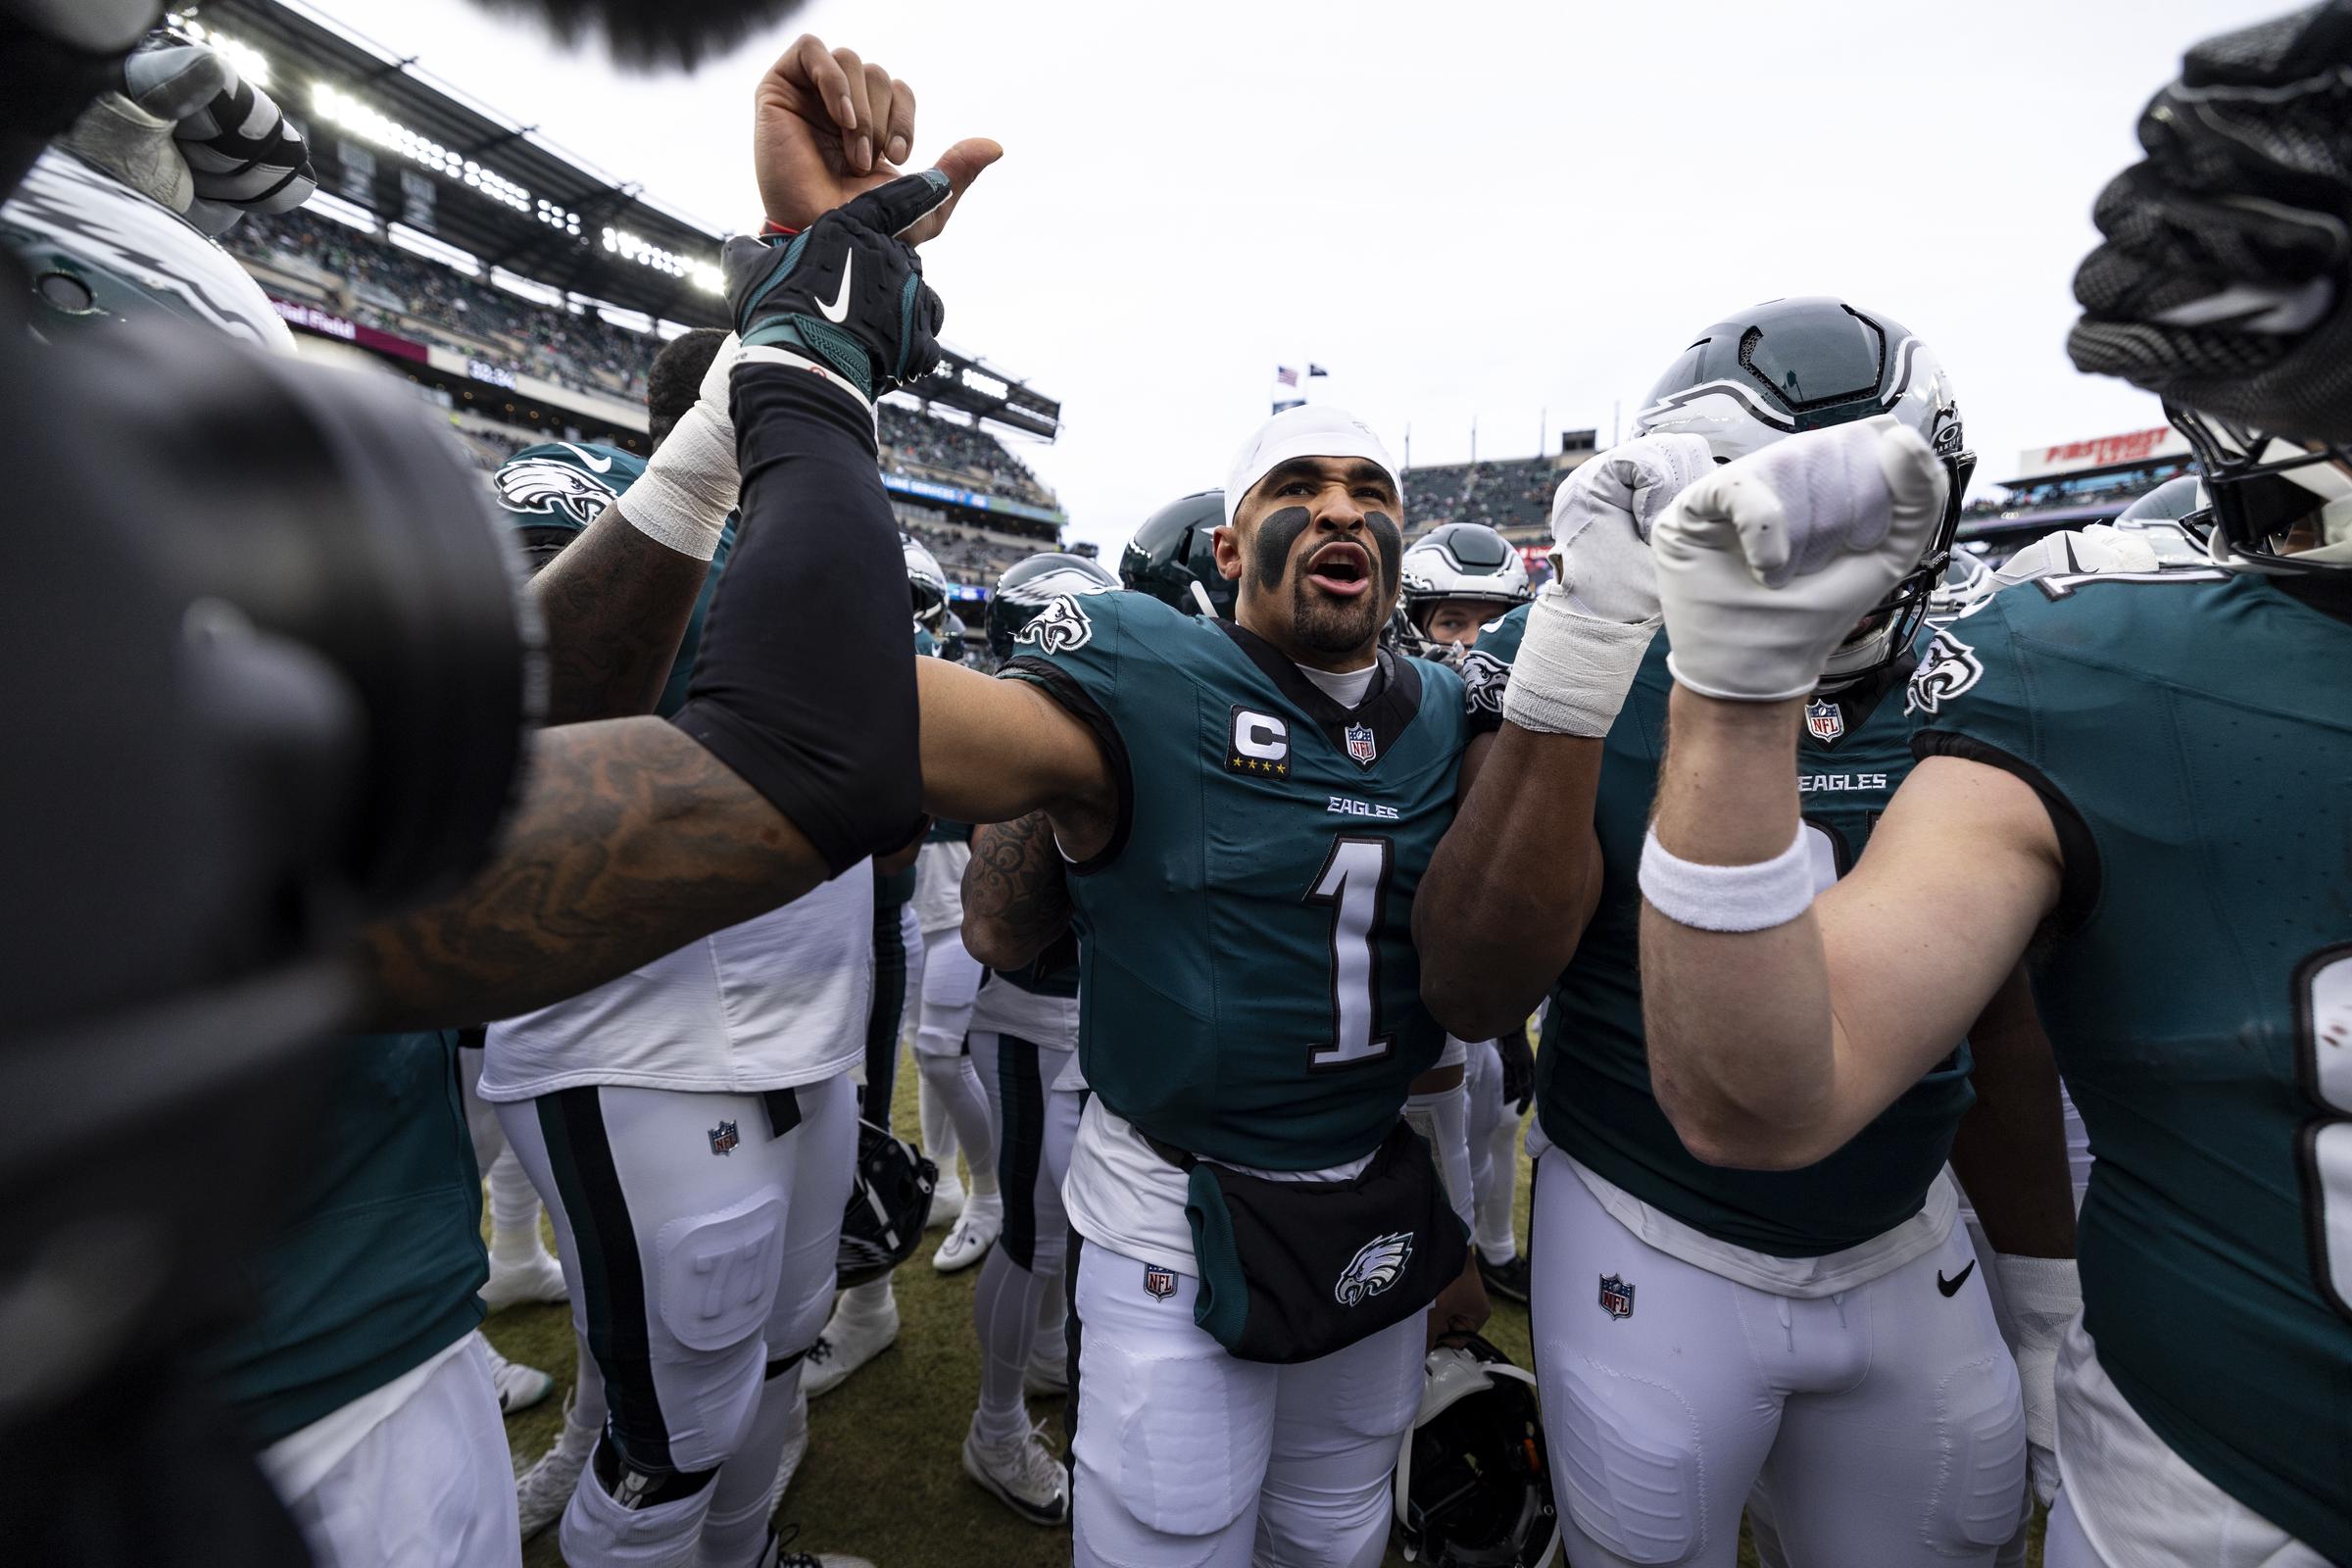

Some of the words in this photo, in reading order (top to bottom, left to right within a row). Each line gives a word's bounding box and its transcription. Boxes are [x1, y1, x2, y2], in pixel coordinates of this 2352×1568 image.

[1235, 710, 1287, 760] C
[1811, 717, 1838, 734] NFL
[1351, 741, 1373, 758] NFL
[1796, 773, 1887, 792] EAGLES
[1327, 796, 1399, 819] EAGLES
[1306, 835, 1393, 1070] 1
[1149, 1273, 1173, 1293] NFL
[1603, 1292, 1629, 1314] NFL
